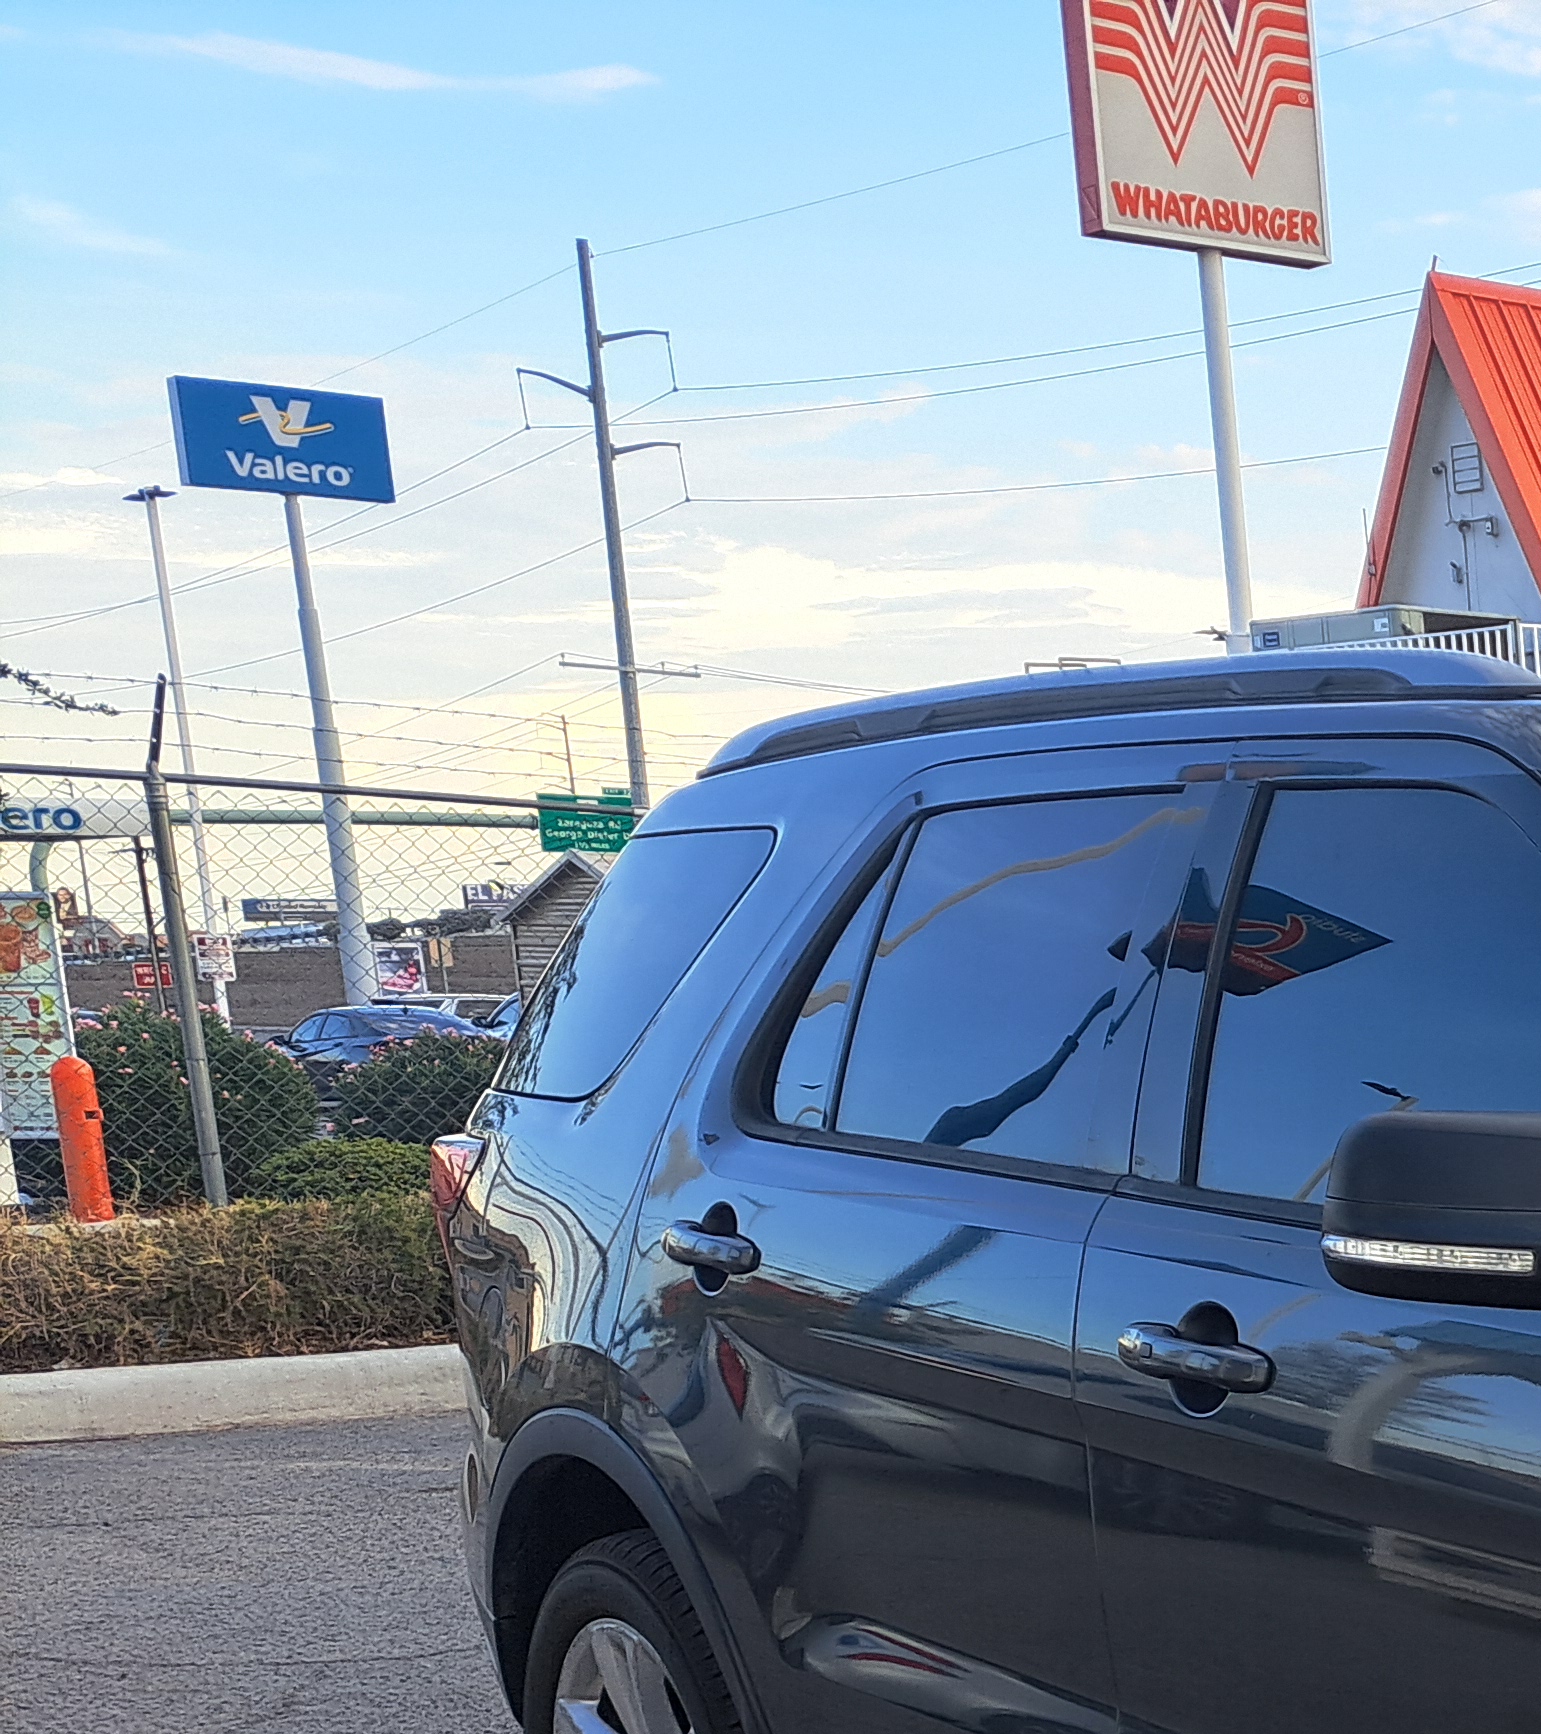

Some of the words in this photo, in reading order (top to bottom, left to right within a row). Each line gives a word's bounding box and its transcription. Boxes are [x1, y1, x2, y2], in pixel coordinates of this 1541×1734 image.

[1110, 180, 1321, 247] WHATABURGER
[225, 449, 351, 487] Valero
[622, 831, 631, 840] D
[466, 884, 488, 900] EL
